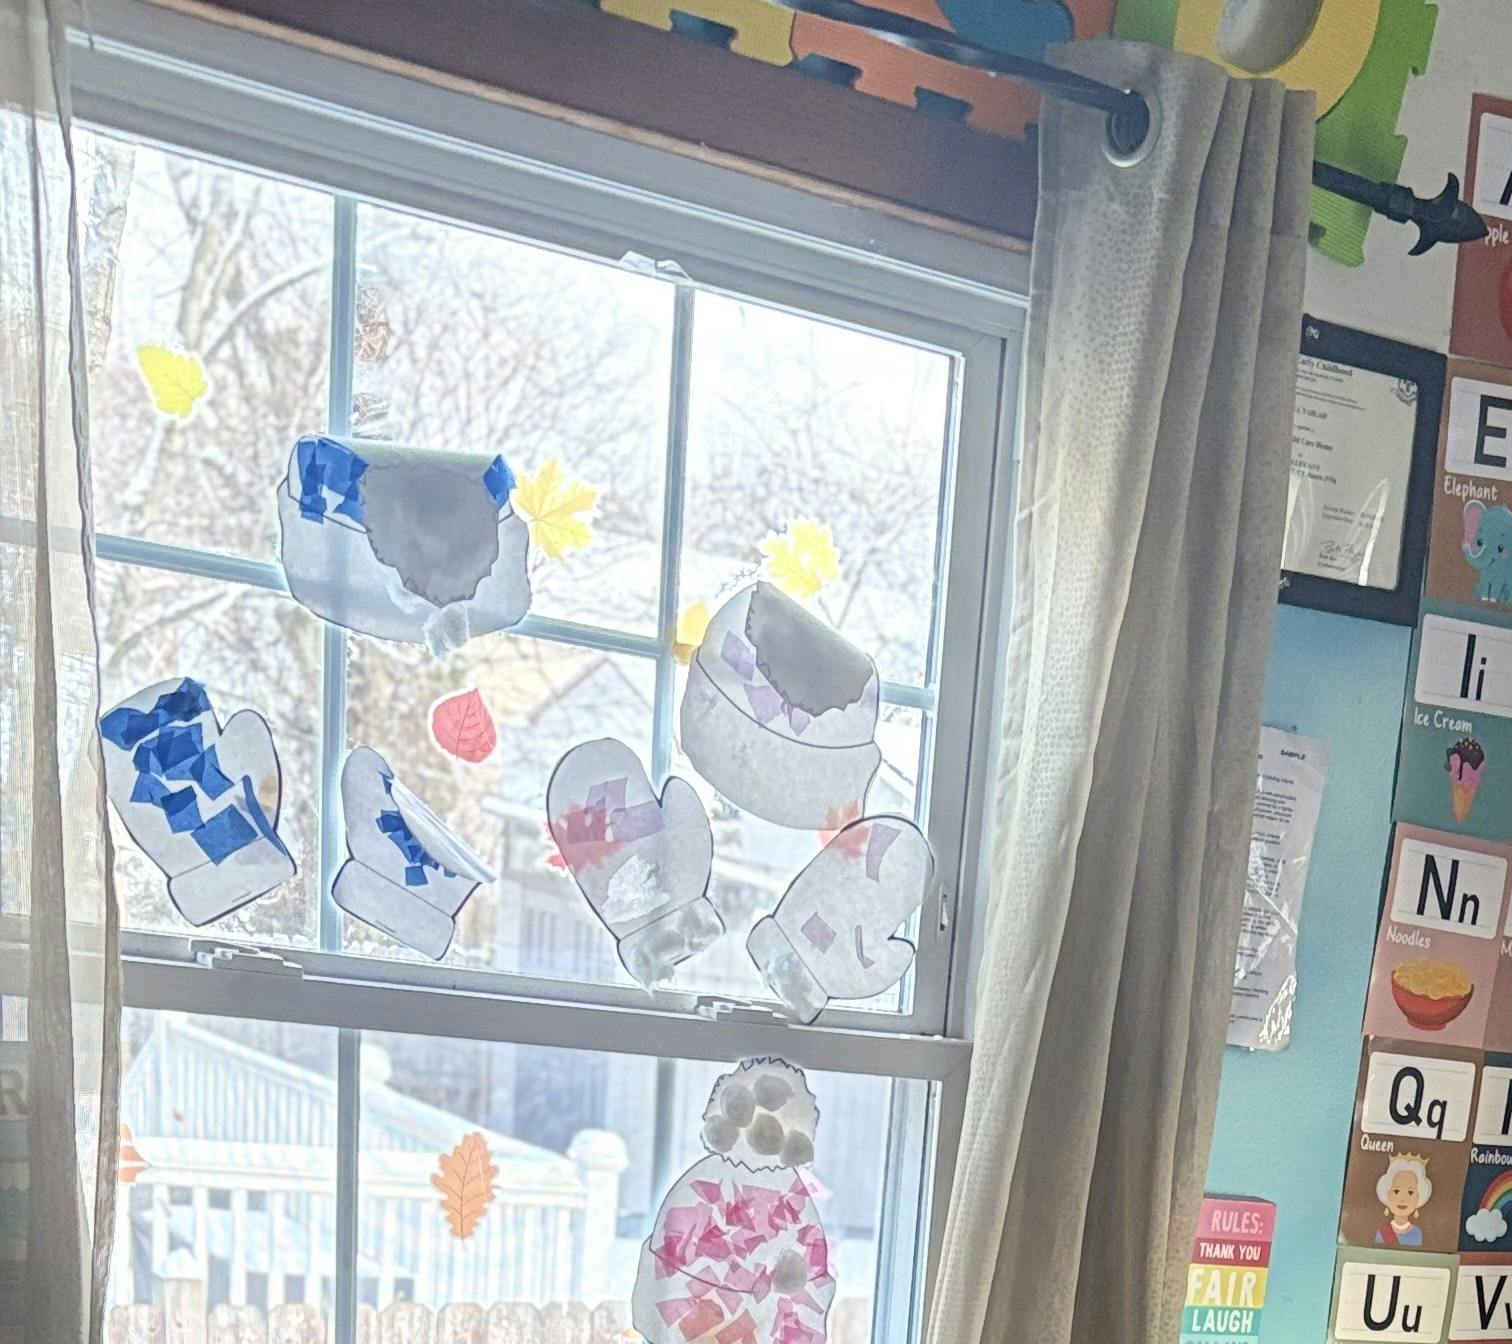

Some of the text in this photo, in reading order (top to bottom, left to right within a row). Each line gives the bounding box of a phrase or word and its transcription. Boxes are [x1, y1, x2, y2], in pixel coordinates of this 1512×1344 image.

[1444, 475, 1498, 501] Elephant
[1460, 634, 1487, 701] Ii
[1414, 709, 1473, 734] Ice Cream
[1417, 854, 1480, 927] Nn
[1387, 926, 1432, 950] Noodles
[1389, 1067, 1447, 1140] Qq
[1360, 1134, 1395, 1156] Queen
[1211, 1208, 1263, 1234] RULES:
[1199, 1241, 1261, 1261] THANK YOU
[1186, 1268, 1257, 1307] FAIR
[1362, 1275, 1423, 1334] Uu
[1191, 1309, 1254, 1333] LAUGH
